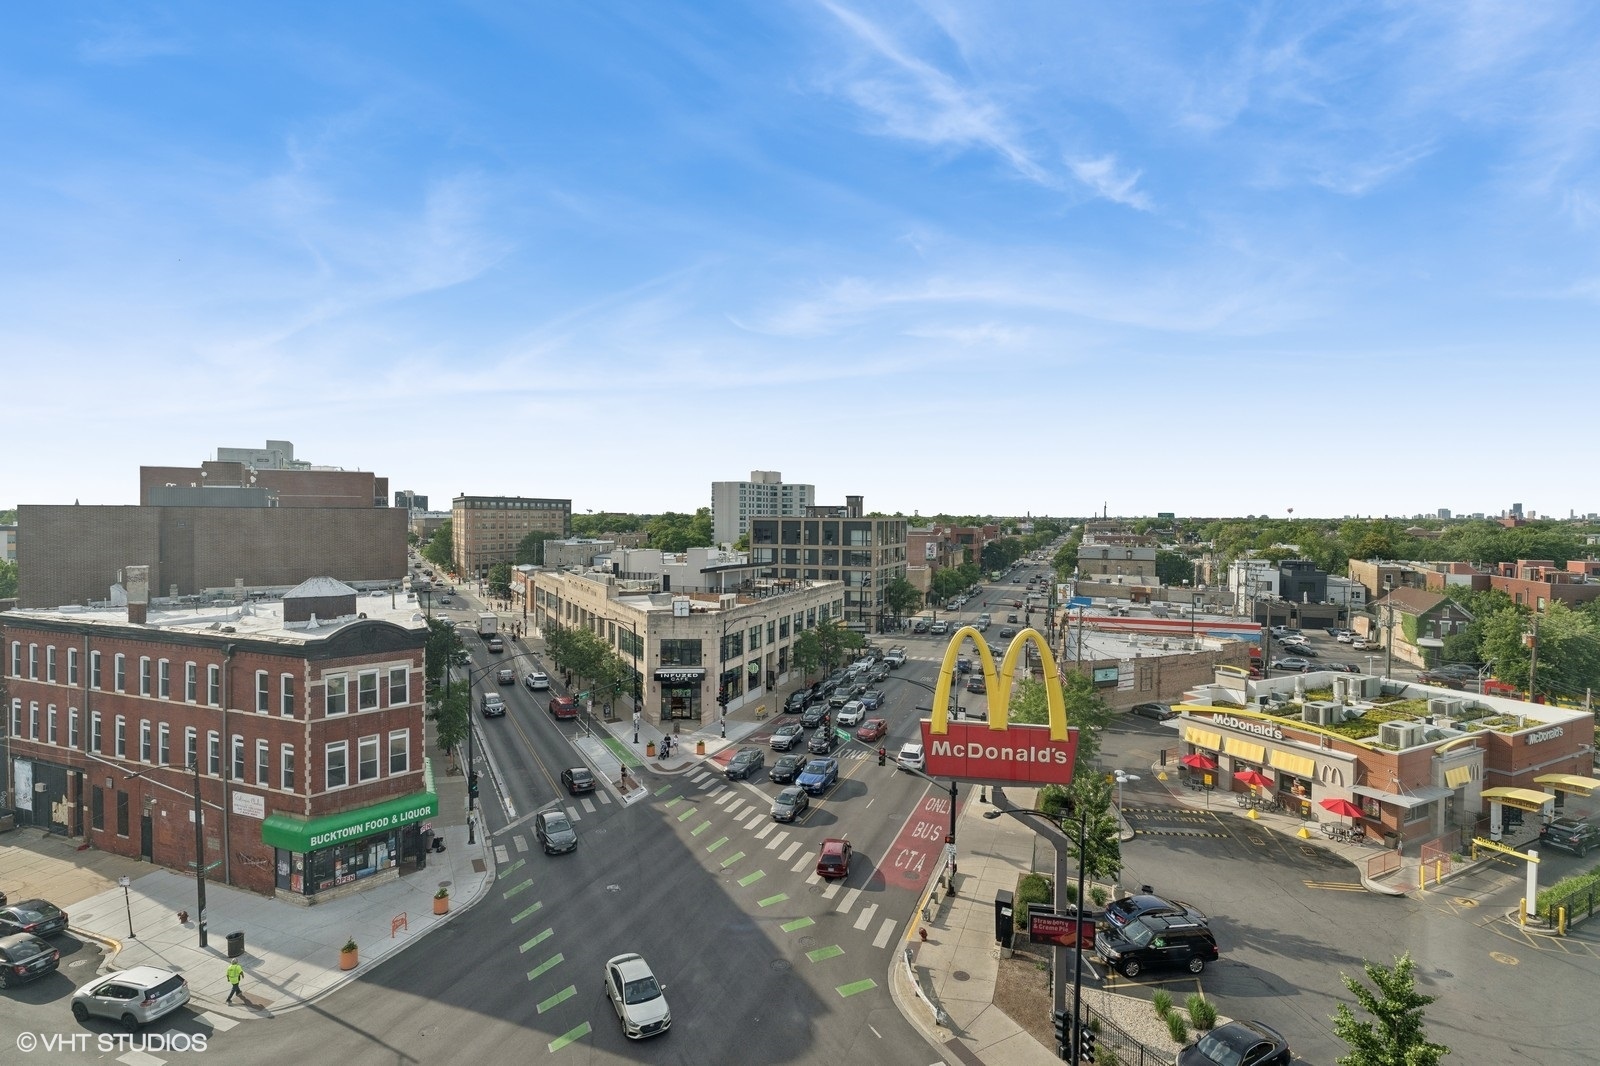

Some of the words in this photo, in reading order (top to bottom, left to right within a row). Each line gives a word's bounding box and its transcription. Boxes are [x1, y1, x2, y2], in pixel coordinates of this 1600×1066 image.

[1212, 713, 1283, 740] McDonald's
[1528, 726, 1564, 746] McDonald's
[931, 740, 1067, 764] McDonald's
[310, 825, 363, 847] BUCKTOWN
[365, 815, 389, 831] FOOD
[391, 814, 398, 824] &
[400, 806, 431, 822] LIQUOR
[911, 821, 943, 841] BUS
[894, 848, 927, 872] CTA
[335, 874, 355, 885] OPEN
[1033, 917, 1069, 928] Strawberry
